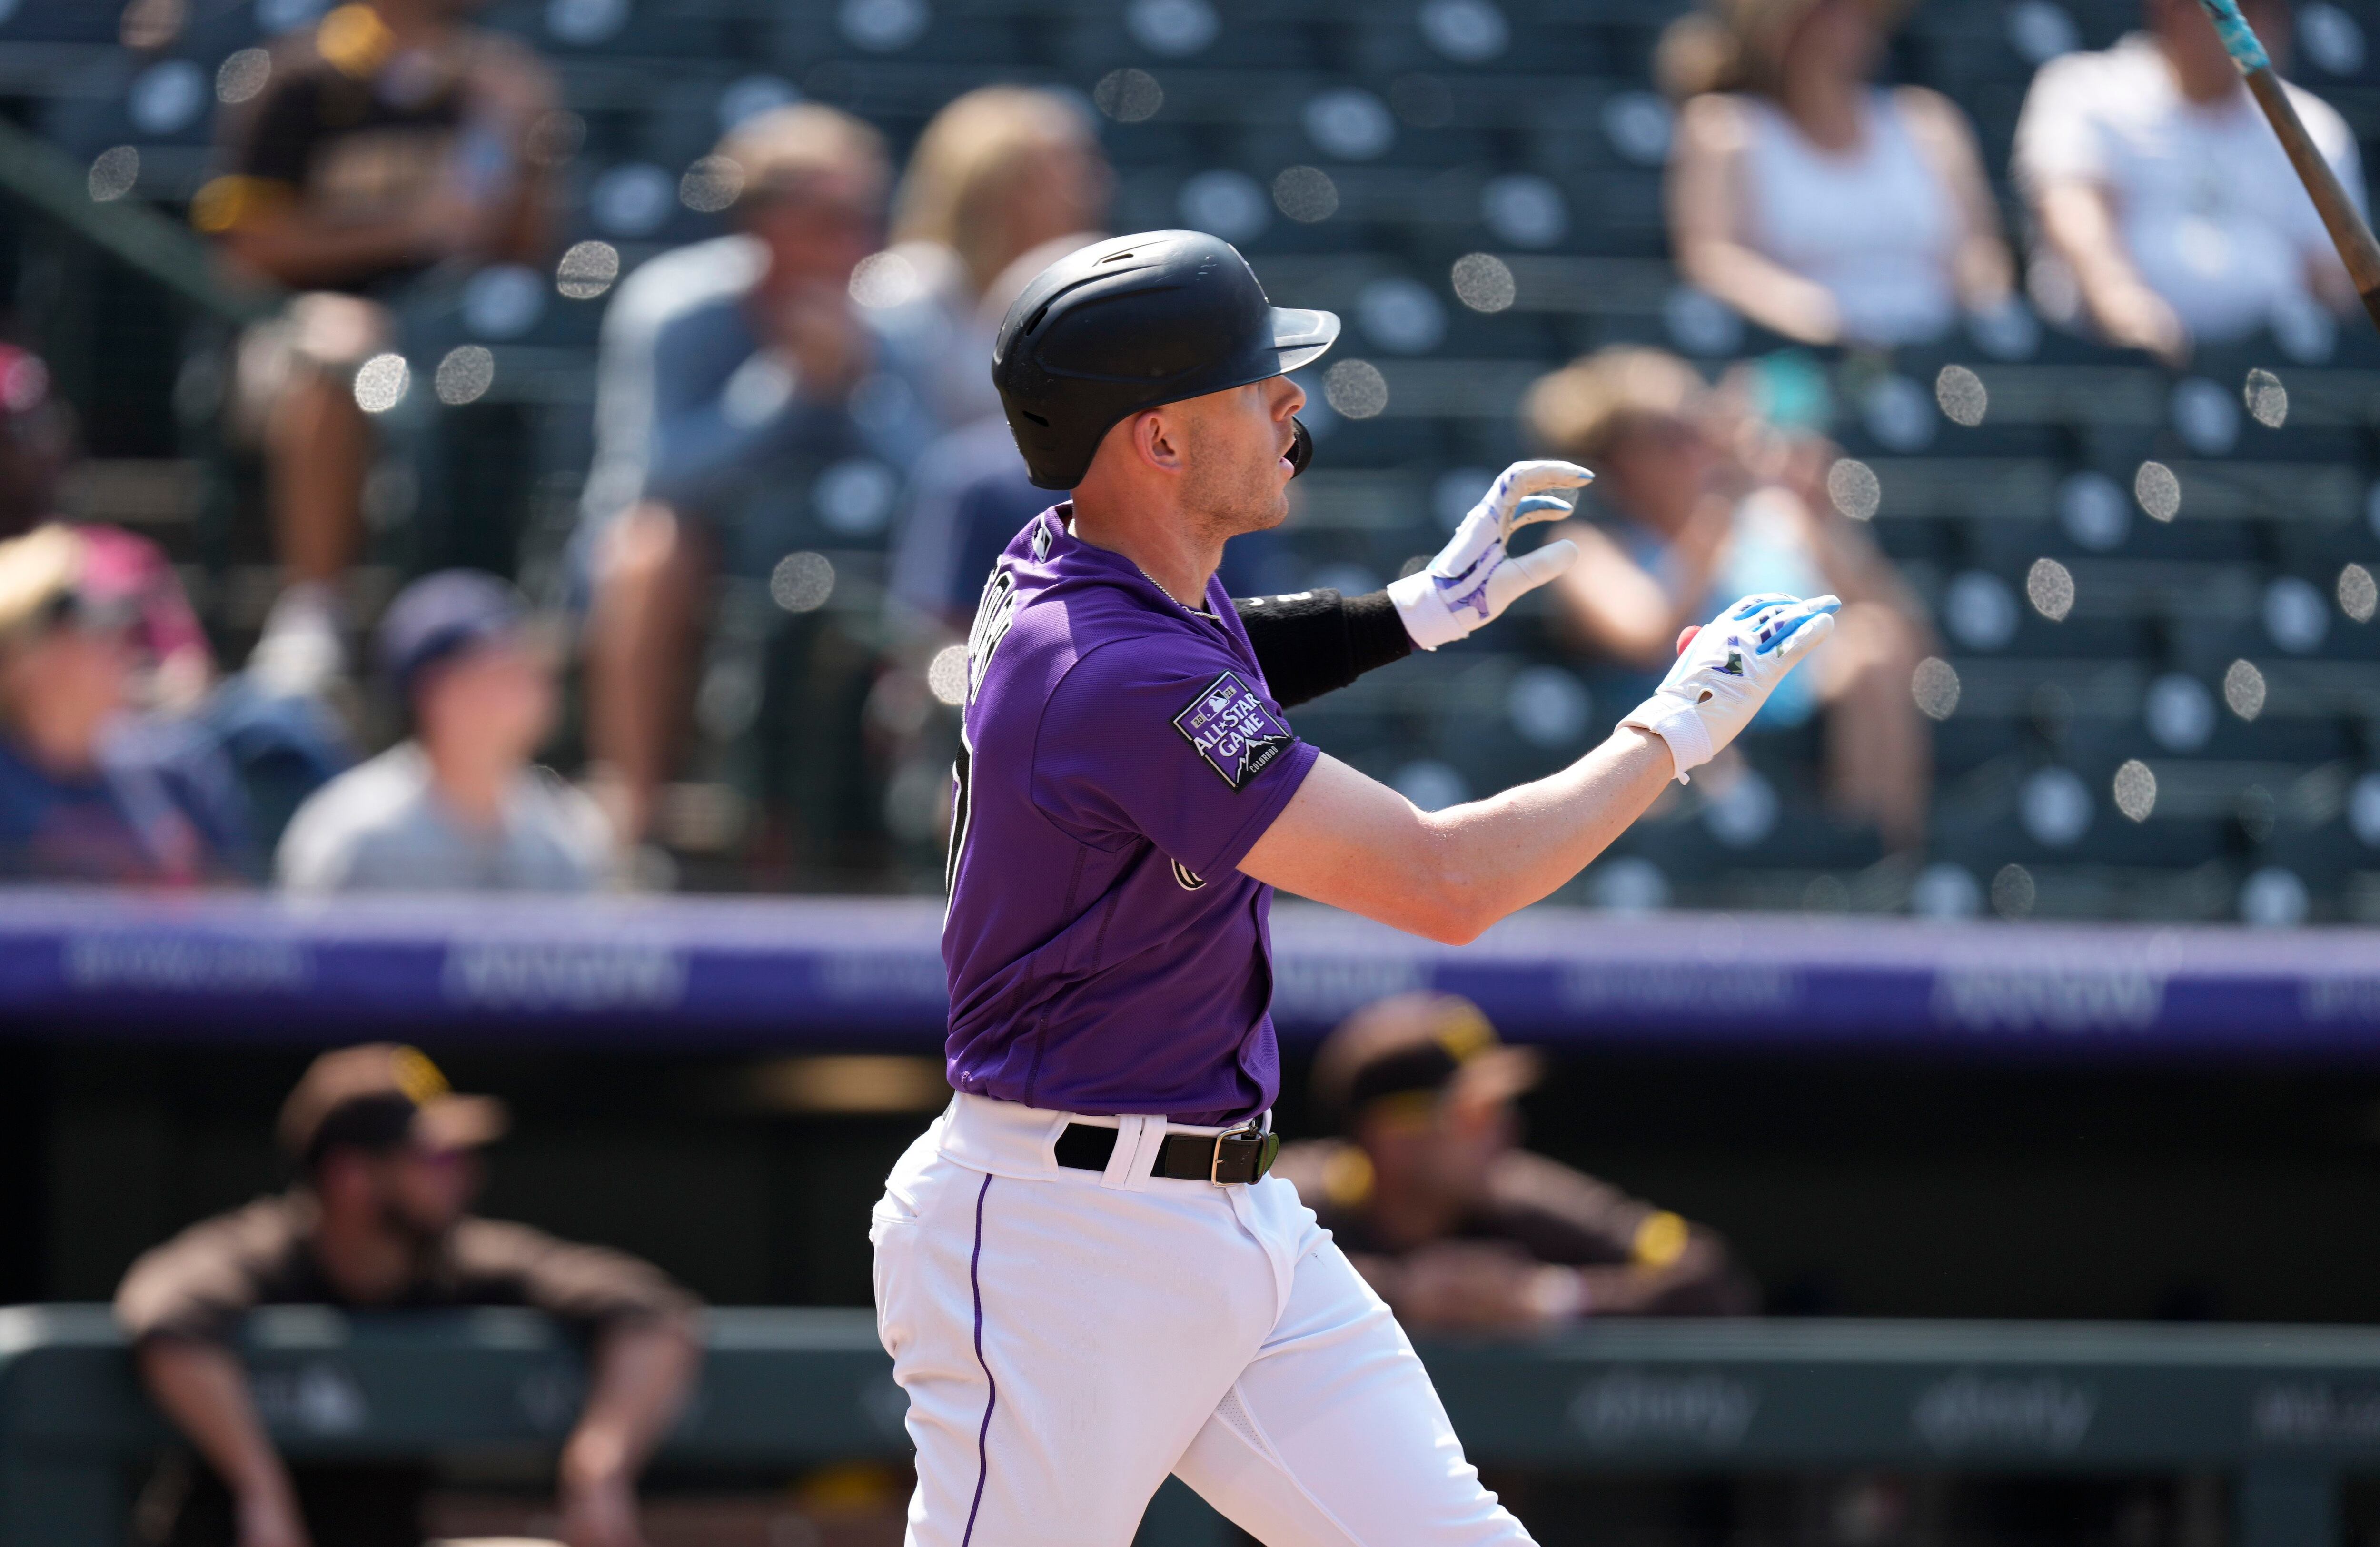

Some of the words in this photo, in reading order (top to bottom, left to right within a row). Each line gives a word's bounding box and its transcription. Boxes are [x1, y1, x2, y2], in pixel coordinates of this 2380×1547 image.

[1194, 716, 1204, 725] 20
[1225, 689, 1233, 697] 21
[1219, 713, 1265, 757] GAME
[1250, 745, 1279, 773] COLORADO
